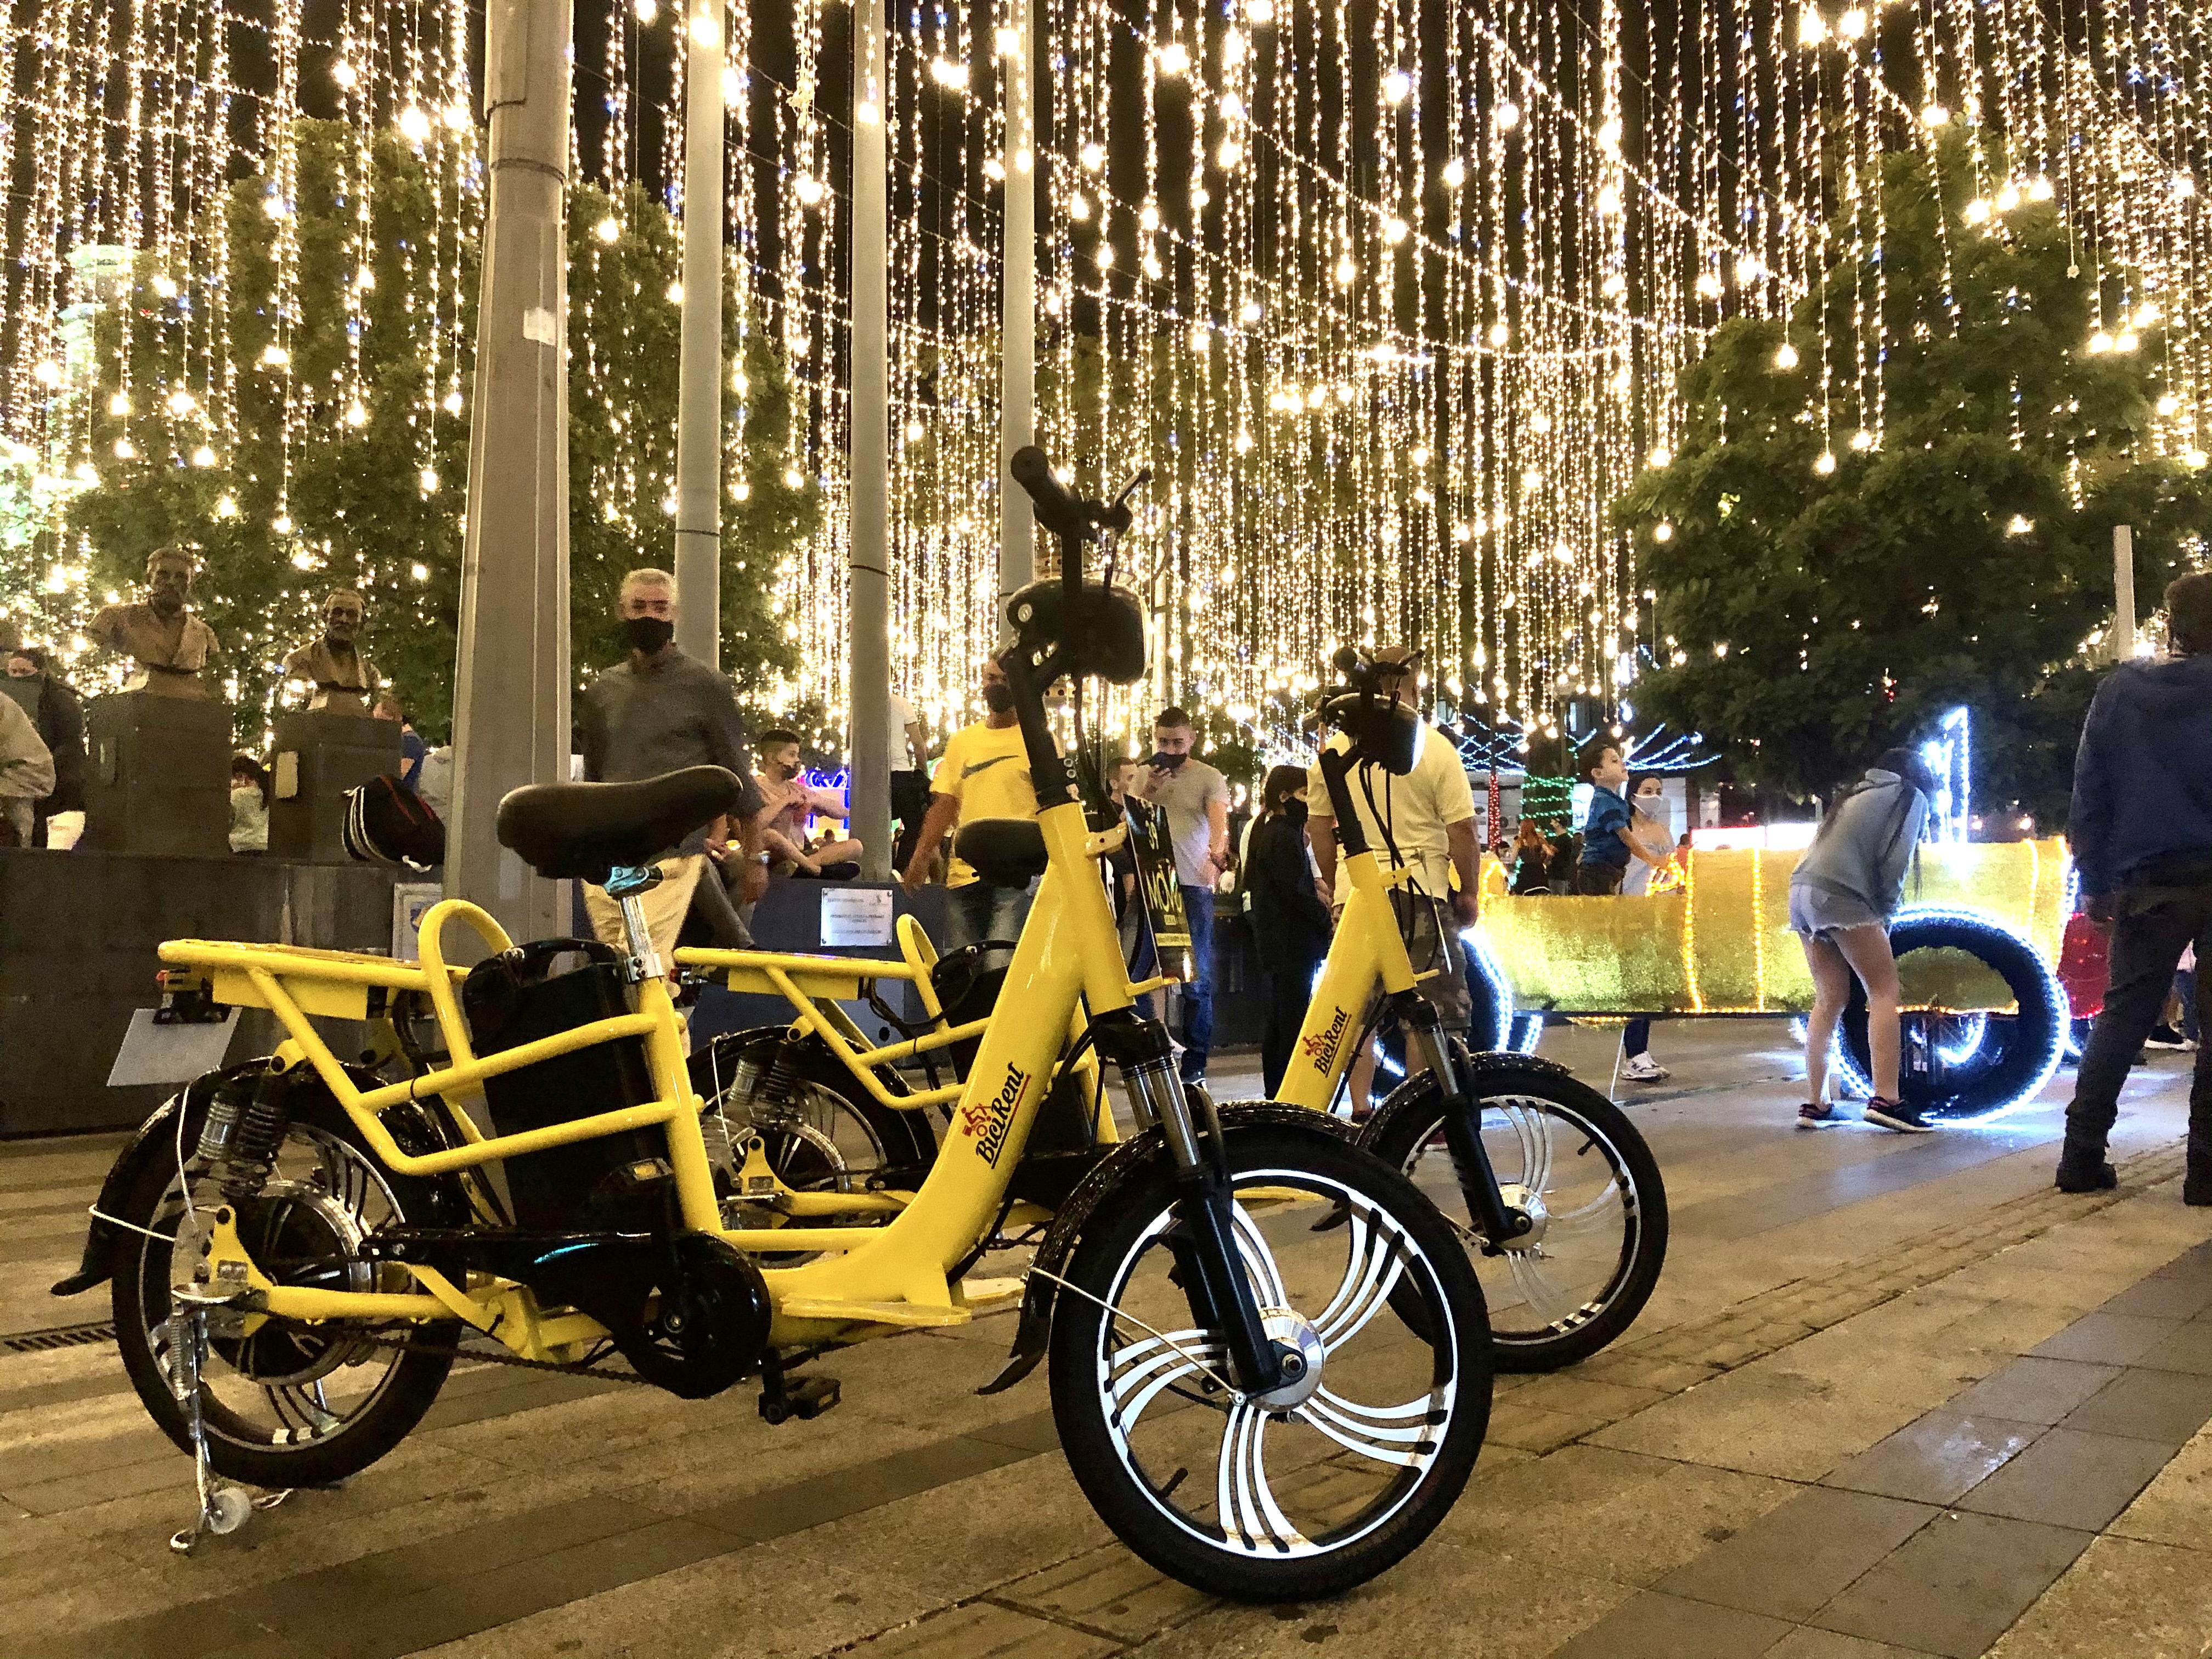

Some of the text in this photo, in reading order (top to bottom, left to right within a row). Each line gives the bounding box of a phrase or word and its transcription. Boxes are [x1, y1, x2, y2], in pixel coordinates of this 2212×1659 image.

[1144, 820, 1159, 850] 39
[1314, 1006, 1347, 1075] BiciRent
[976, 1061, 1024, 1165] BiciRent
